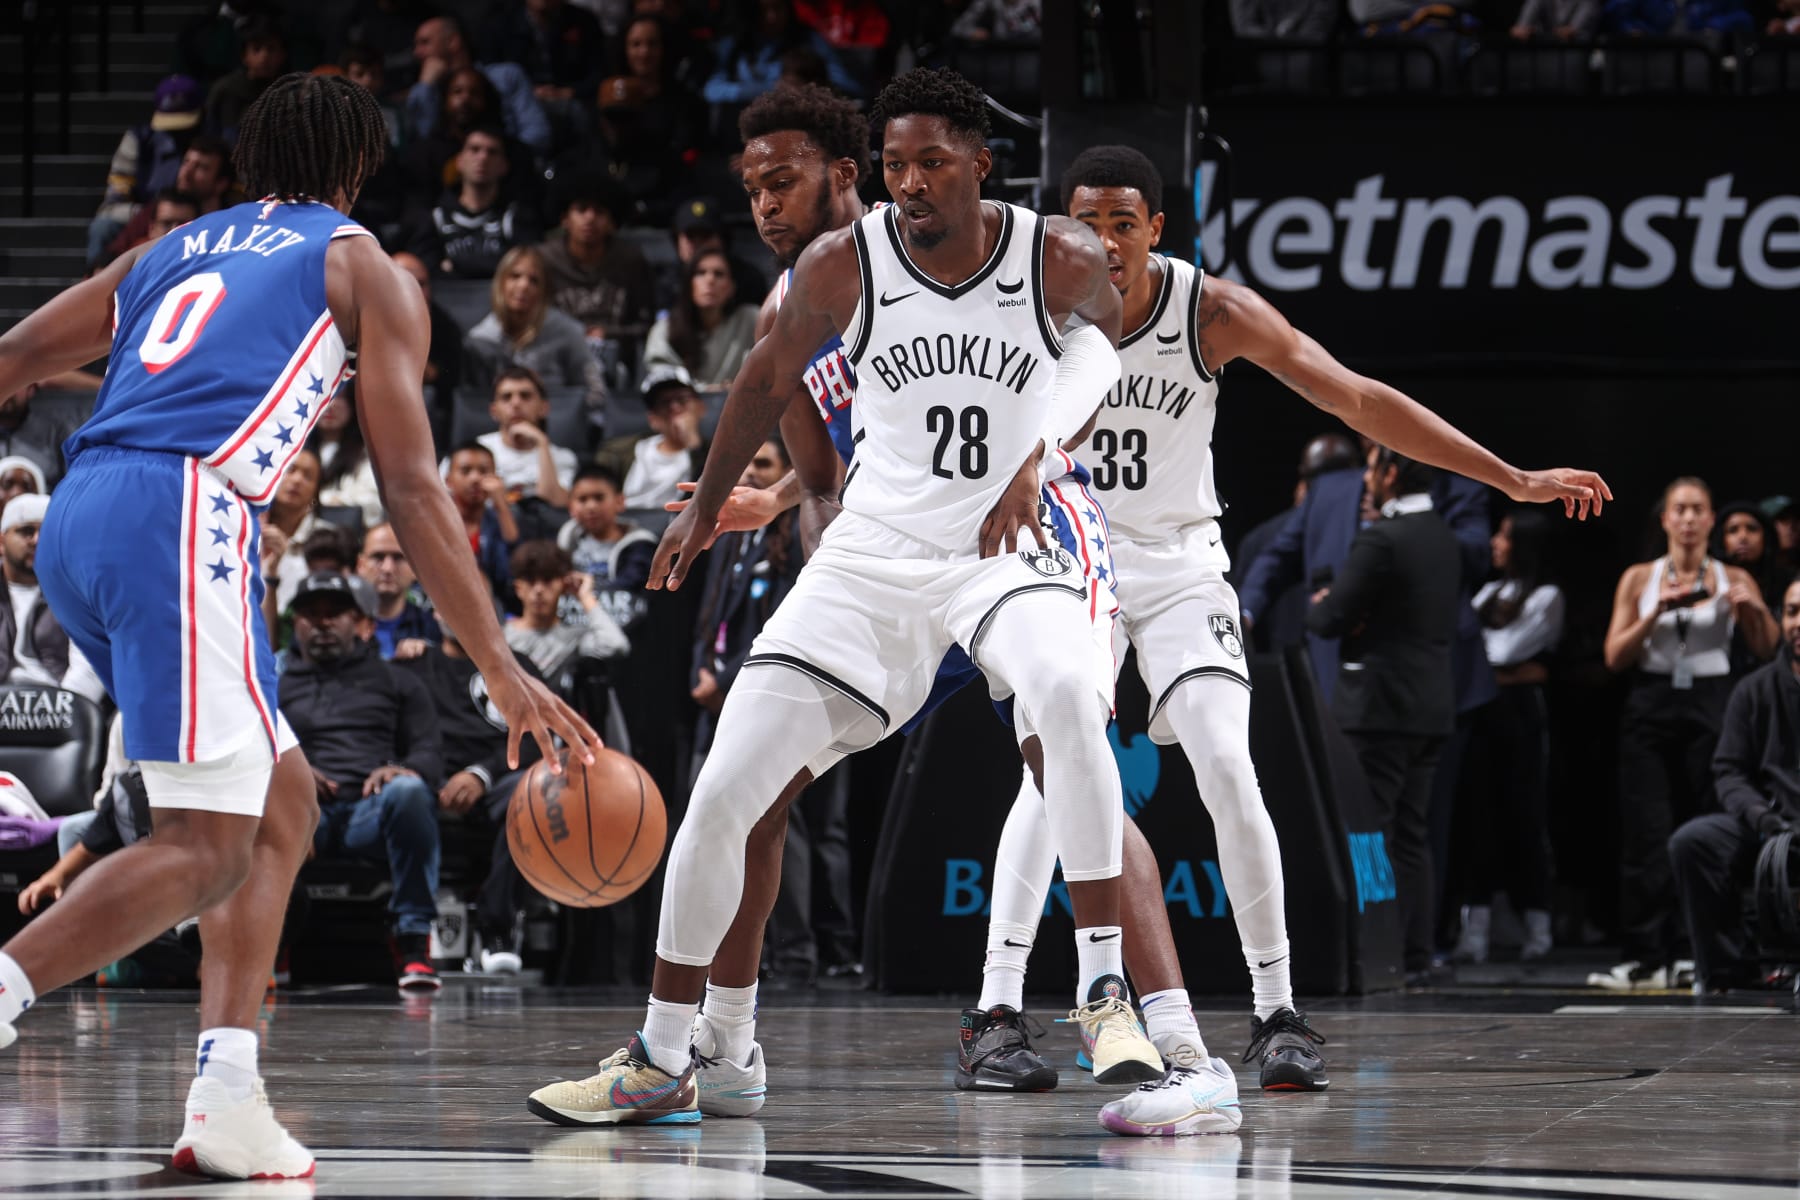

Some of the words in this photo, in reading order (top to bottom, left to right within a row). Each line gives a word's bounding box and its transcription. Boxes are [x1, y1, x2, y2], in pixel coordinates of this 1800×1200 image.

[181, 224, 306, 260] MAXEY
[1200, 160, 1800, 291] ketmaste
[138, 272, 228, 375] 0
[997, 298, 1027, 309] Webull
[871, 333, 1040, 395] BROOKLYN
[1157, 348, 1183, 357] Webull
[802, 345, 854, 424] PH
[1106, 374, 1197, 420] OKLYN
[925, 405, 989, 480] 28
[1092, 429, 1148, 491] 33
[1212, 616, 1240, 636] NET
[0, 690, 74, 714] ATAR
[0, 713, 74, 730] AIRWAYS
